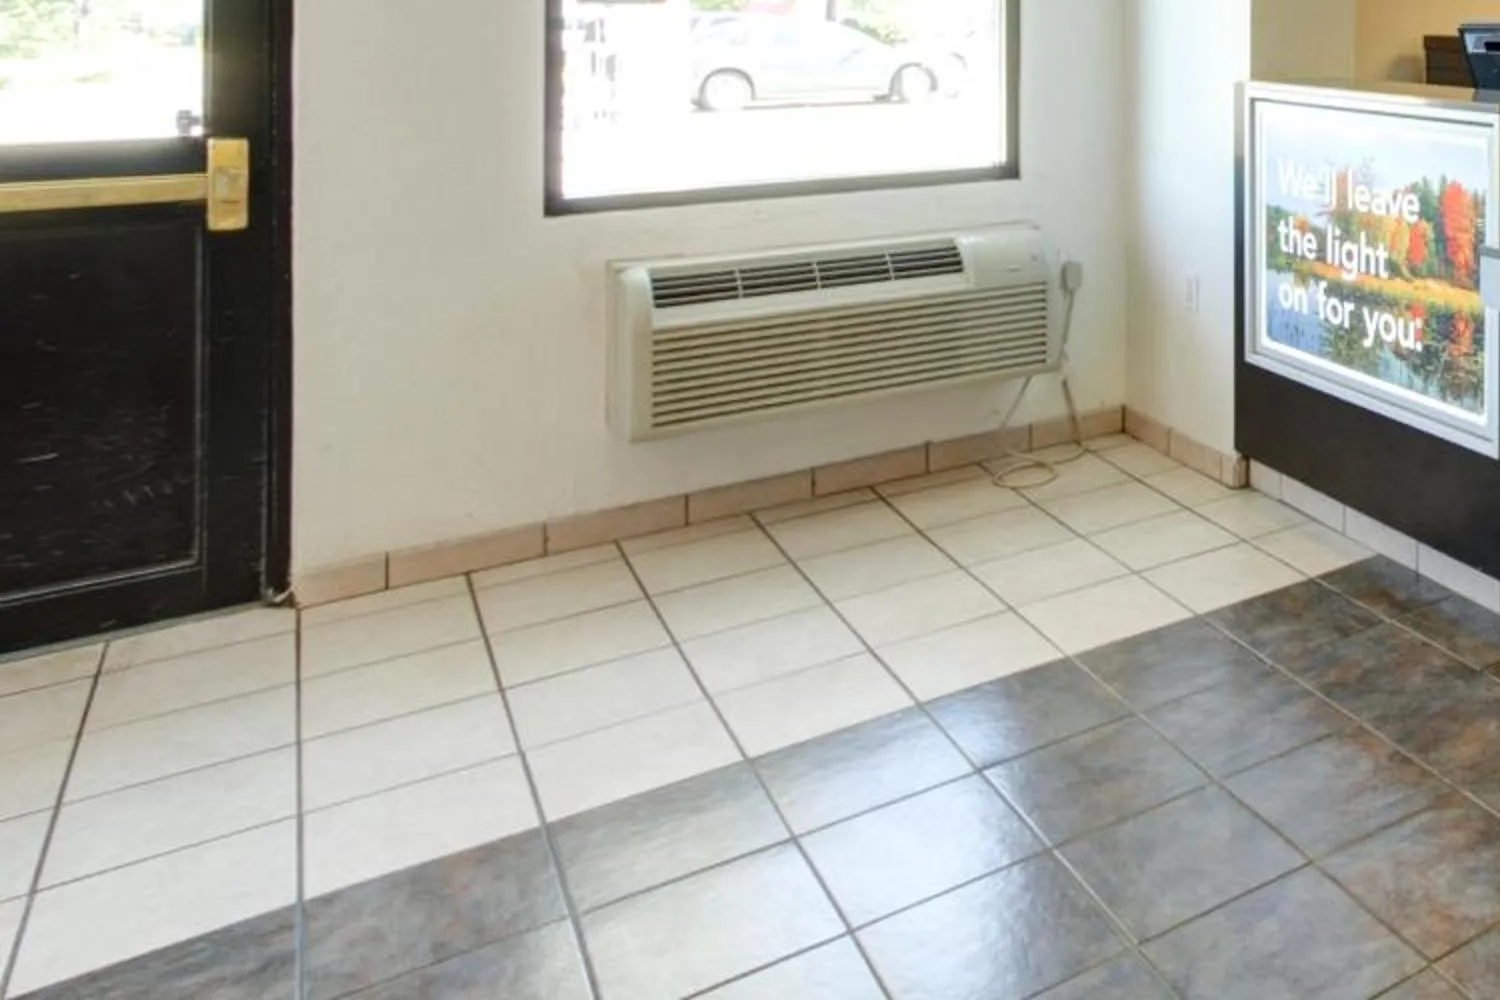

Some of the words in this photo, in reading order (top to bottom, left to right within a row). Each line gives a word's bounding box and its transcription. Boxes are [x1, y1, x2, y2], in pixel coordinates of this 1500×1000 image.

[1347, 167, 1421, 224] leave
[1277, 215, 1317, 259] the
[1326, 224, 1390, 281] light
[1278, 281, 1308, 314] on
[1316, 279, 1354, 329] for
